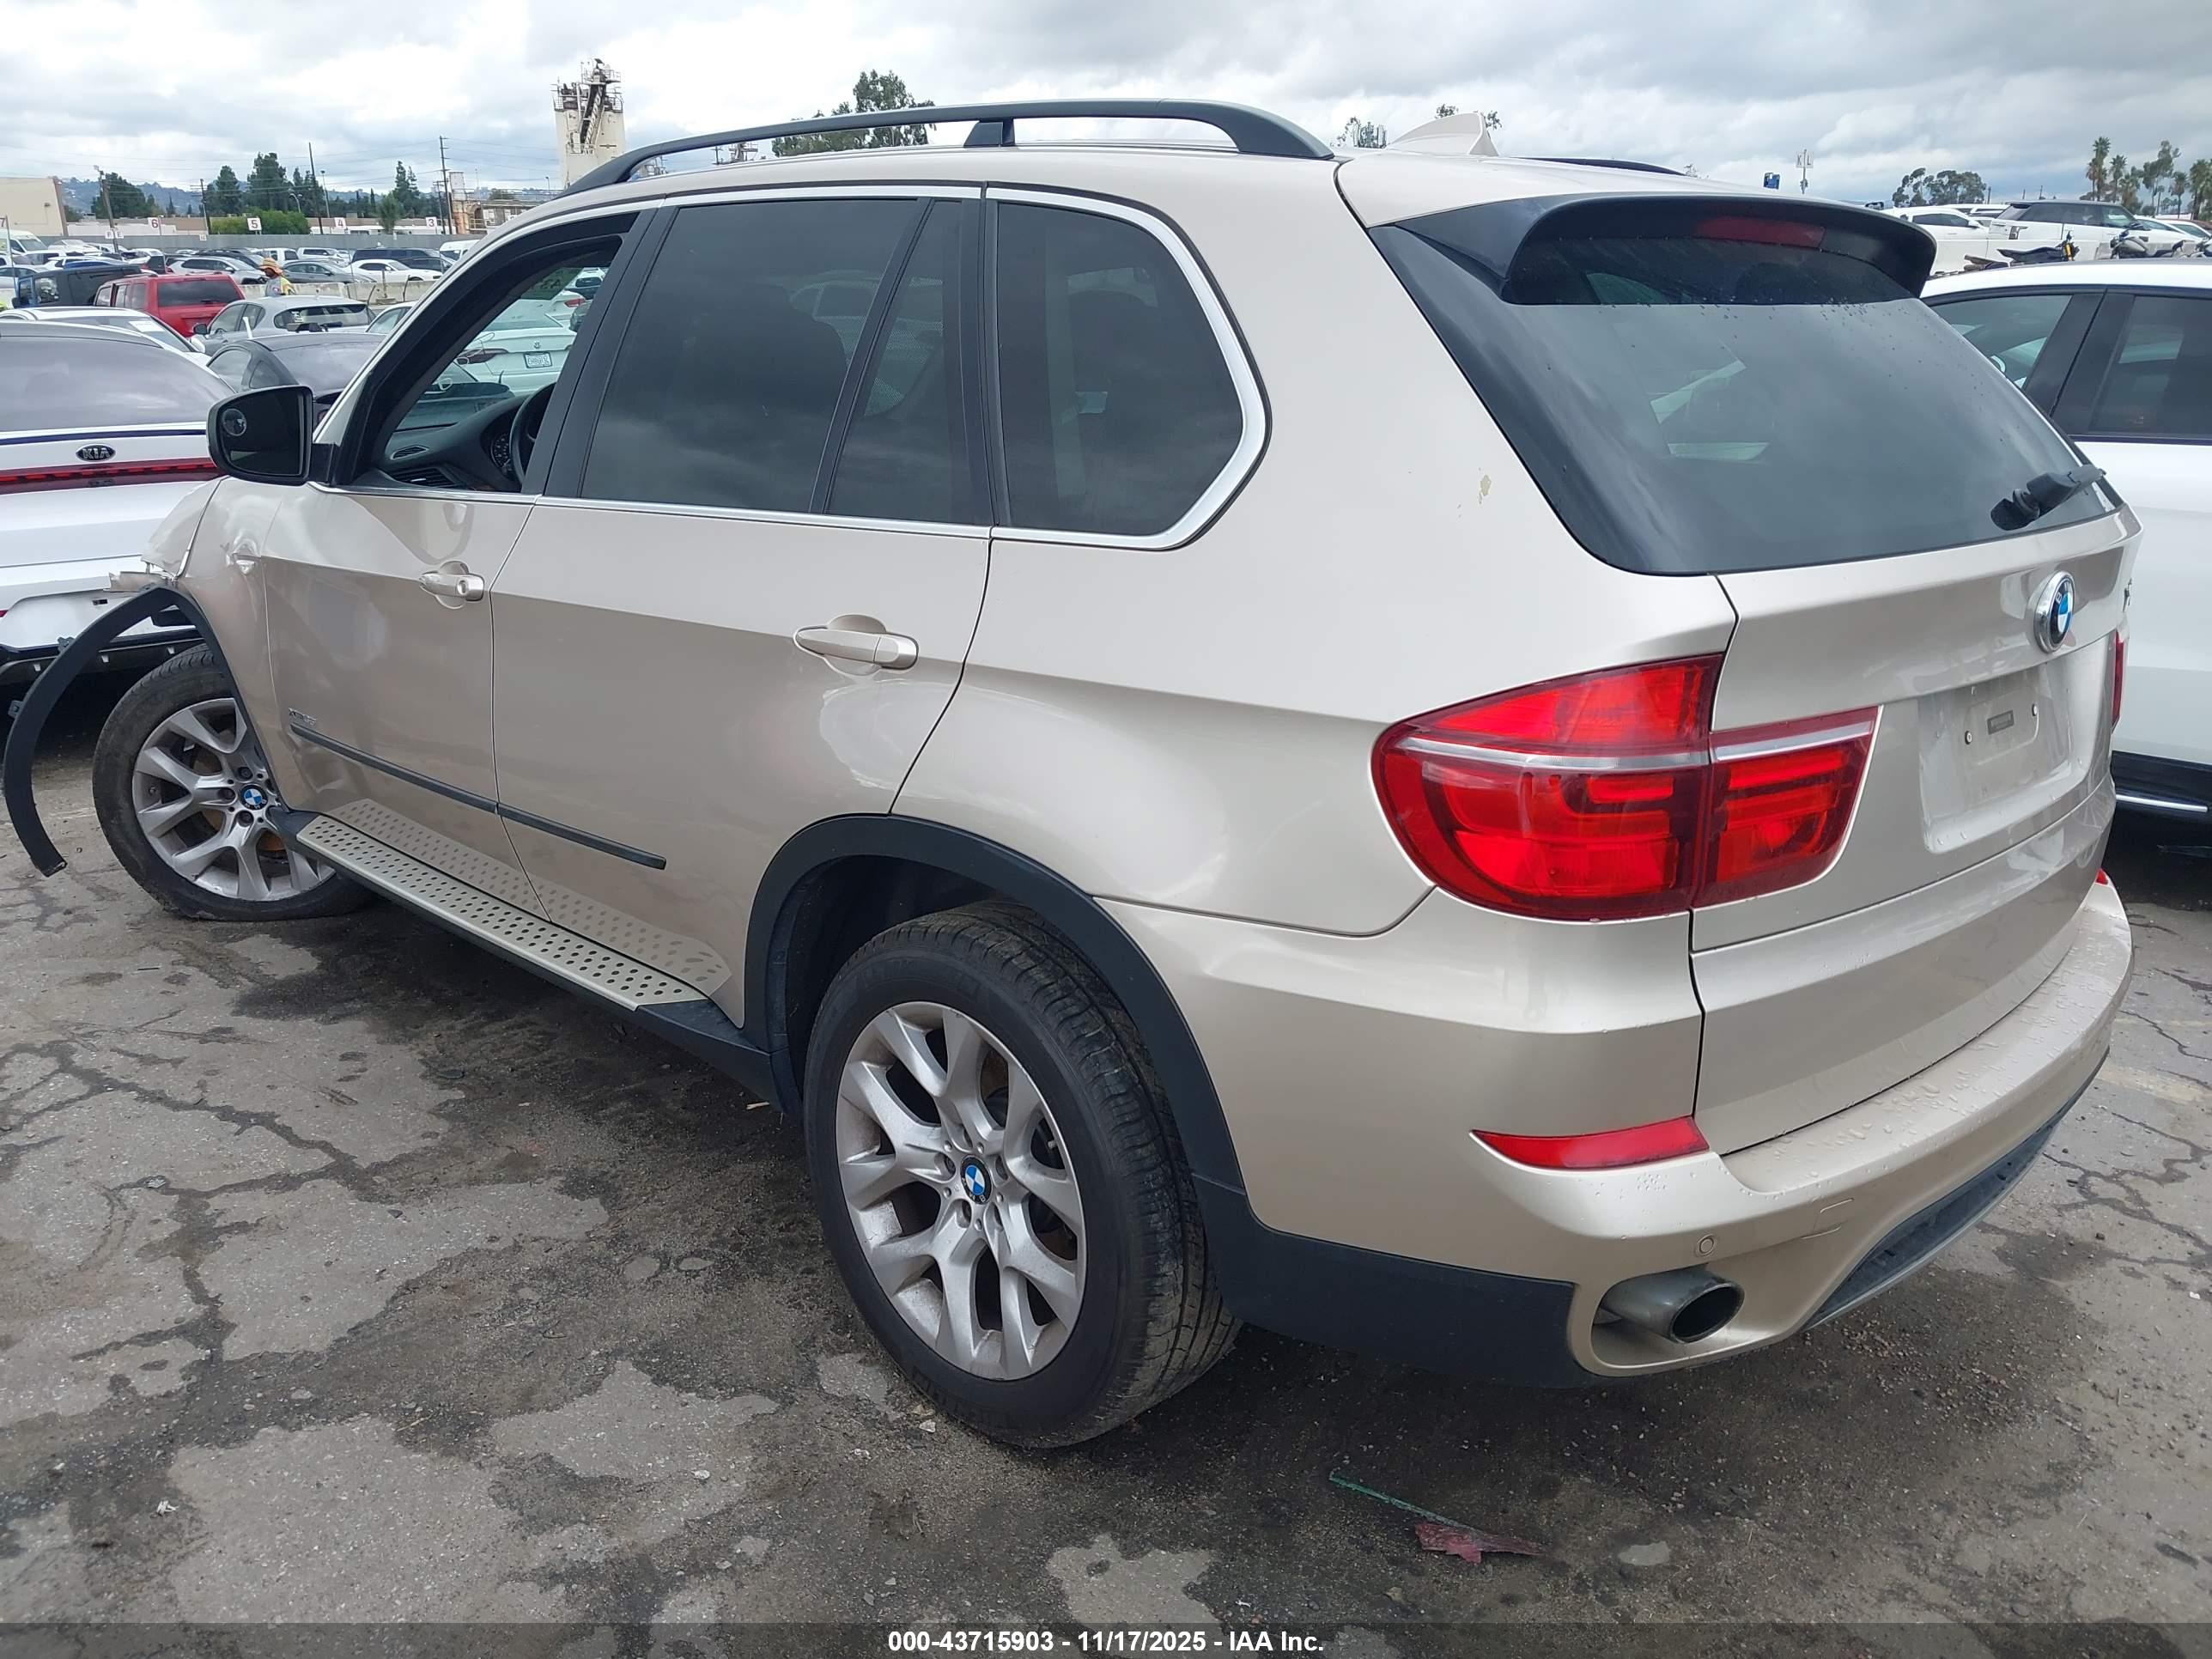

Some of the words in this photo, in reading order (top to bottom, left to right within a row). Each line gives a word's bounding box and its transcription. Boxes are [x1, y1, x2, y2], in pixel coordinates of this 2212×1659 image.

[151, 219, 158, 228] 6
[251, 219, 258, 228] 5
[338, 218, 343, 227] 4
[82, 447, 110, 459] KIA
